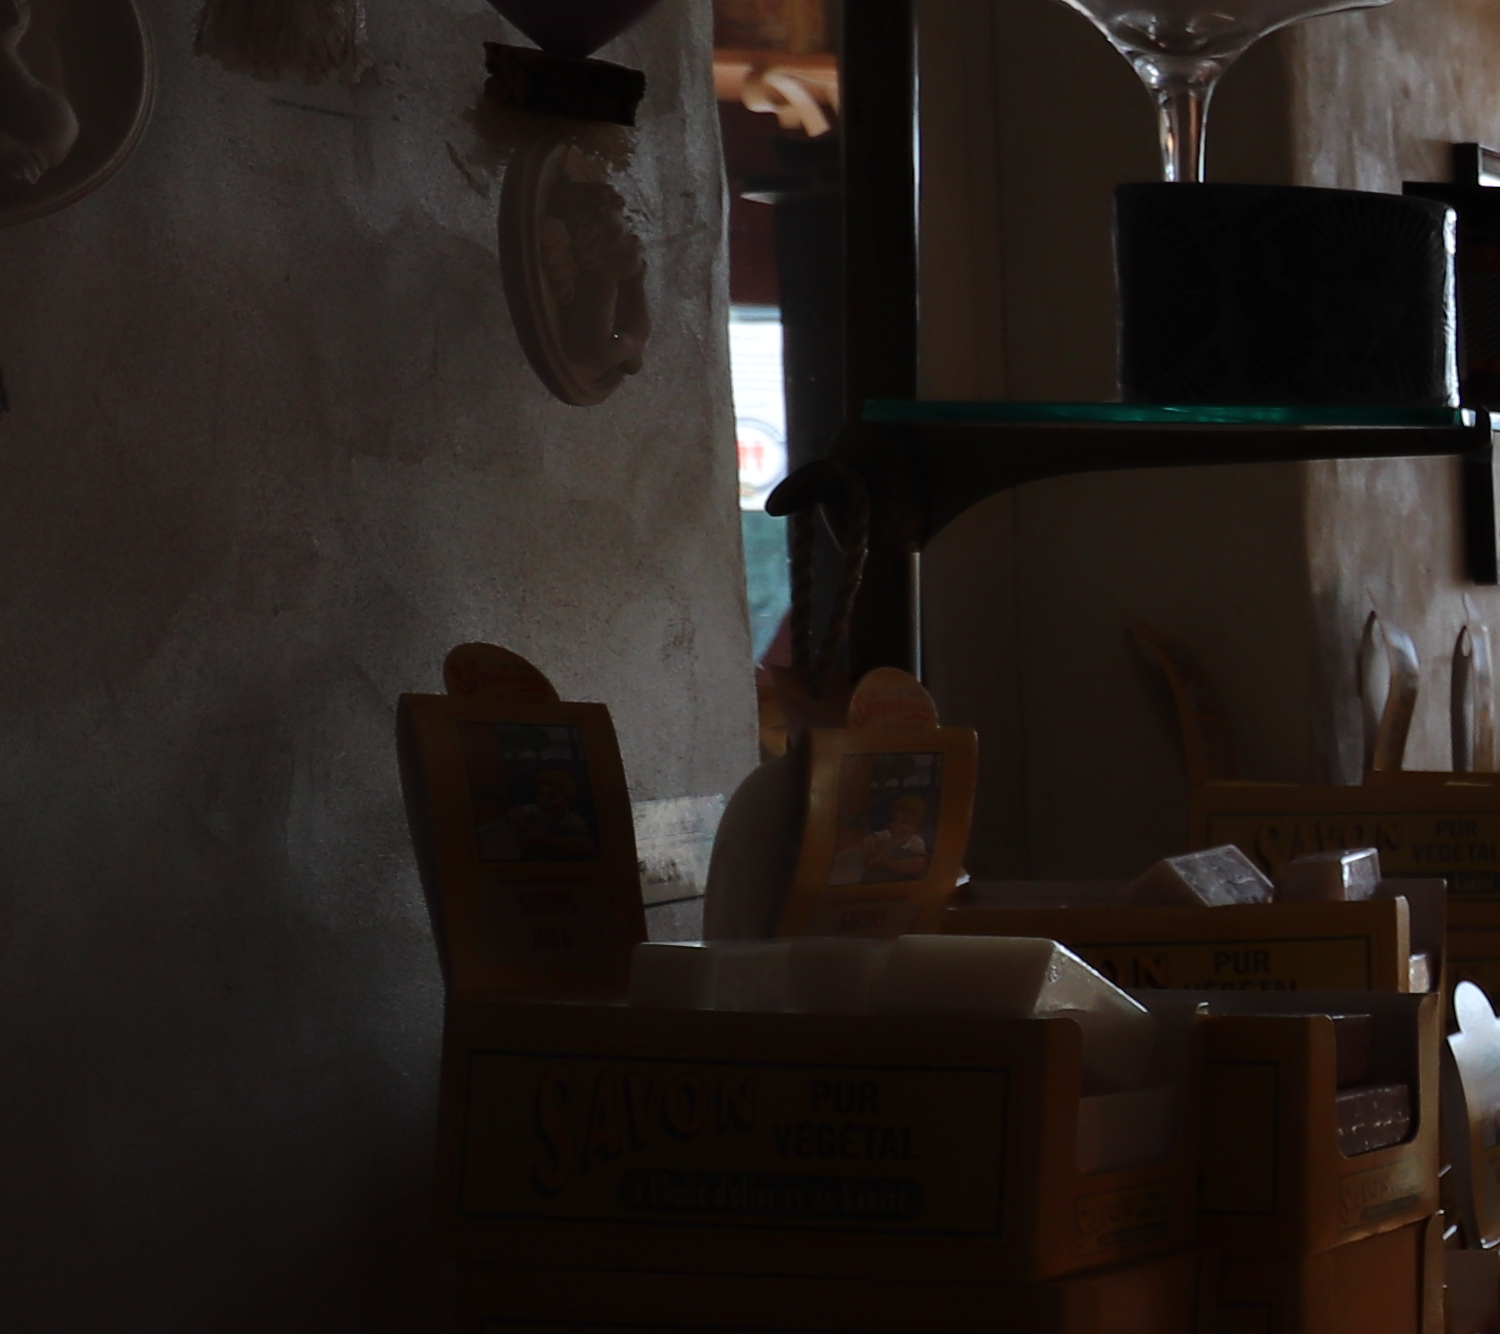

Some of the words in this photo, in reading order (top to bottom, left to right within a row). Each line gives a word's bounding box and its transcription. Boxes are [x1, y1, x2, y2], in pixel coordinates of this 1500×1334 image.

[1212, 950, 1272, 977] PUR
[809, 1078, 881, 1116] PUR
[530, 1061, 758, 1198] SAVON
[772, 1119, 921, 1162] VÉGÉTAL
